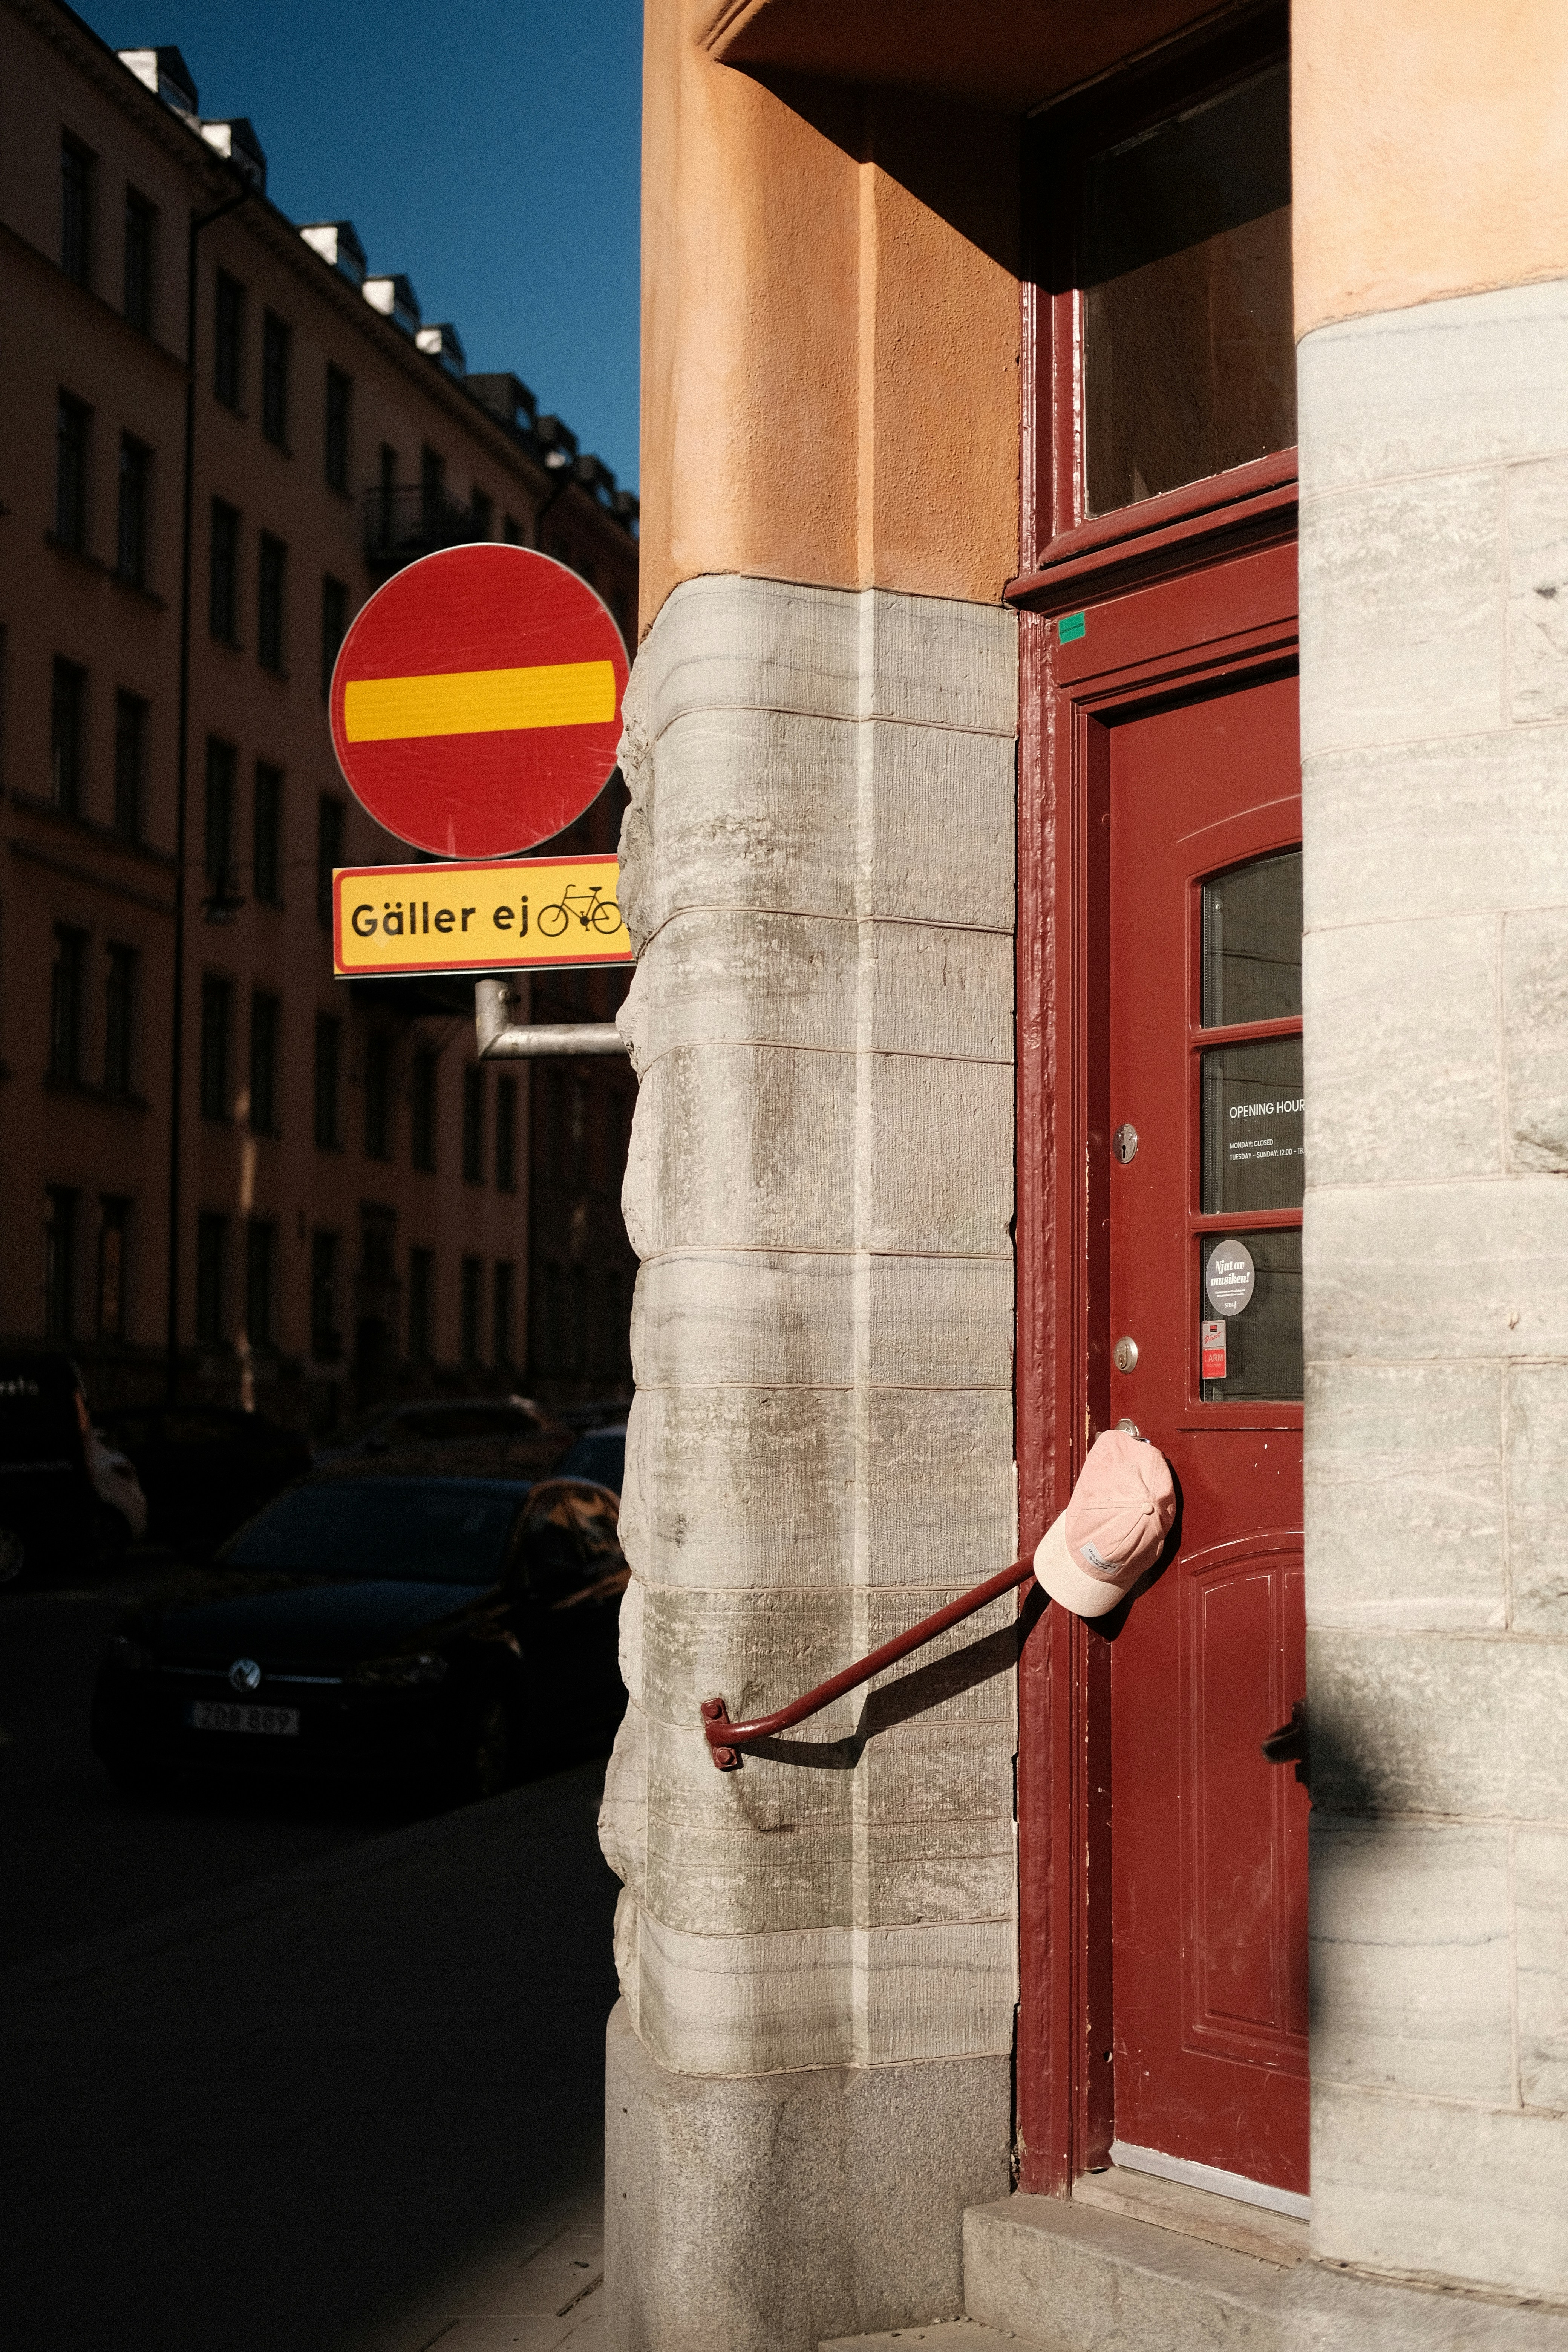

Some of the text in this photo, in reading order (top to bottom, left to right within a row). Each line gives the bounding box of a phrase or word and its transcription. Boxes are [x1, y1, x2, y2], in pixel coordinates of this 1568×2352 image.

[352, 895, 529, 938] Gäller ej
[1230, 1102, 1274, 1118] OPENING
[1257, 1150, 1279, 1158] SUNDAY:
[1215, 1260, 1245, 1274] Njut av
[1210, 1272, 1250, 1286] musiken!
